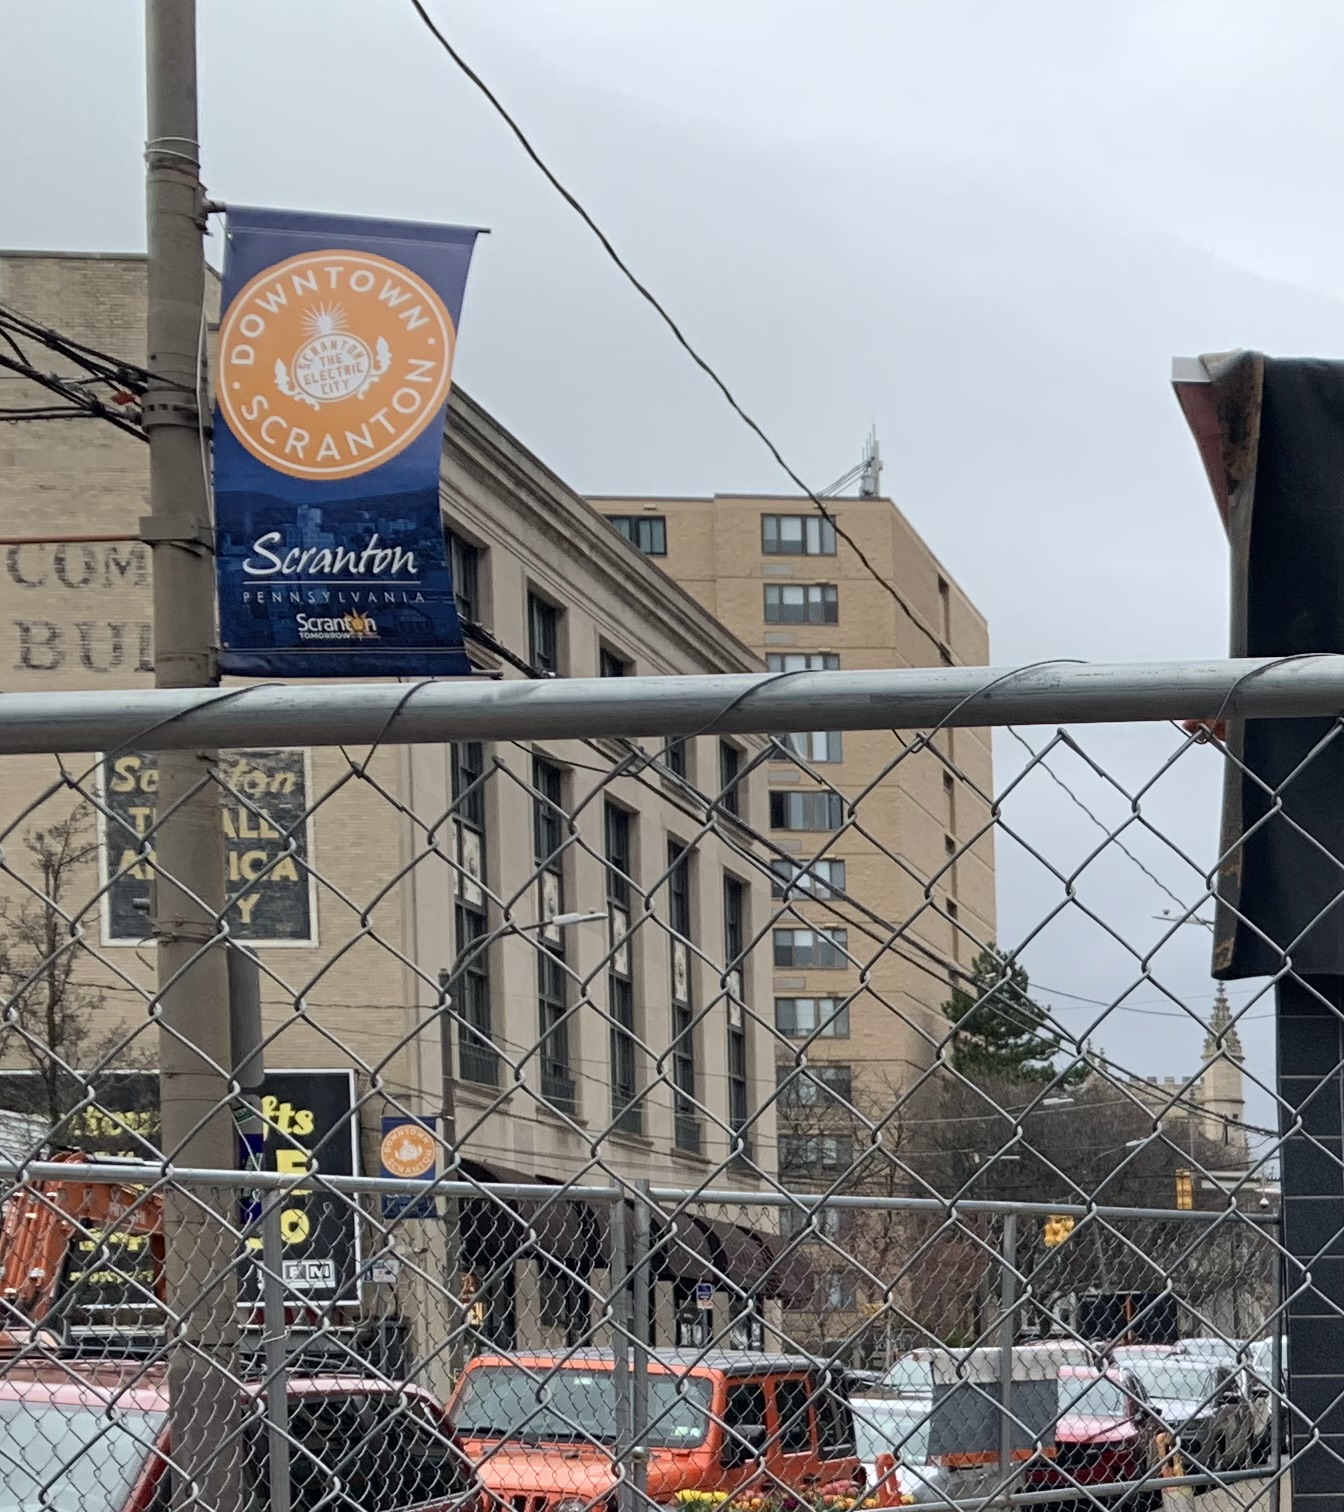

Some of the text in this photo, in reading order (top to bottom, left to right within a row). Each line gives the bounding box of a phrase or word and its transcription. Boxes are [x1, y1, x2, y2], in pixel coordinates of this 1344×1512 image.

[231, 266, 429, 365] DOWNTOWN
[298, 340, 365, 370] SCRANTON
[320, 353, 342, 367] THE
[303, 362, 363, 385] ELECTRIC
[321, 379, 349, 395] CITY
[241, 358, 437, 462] SCRANTON
[242, 531, 418, 576] Scranton
[243, 591, 425, 603] PENNSYLVANIA
[296, 608, 377, 633] Scranton
[299, 632, 350, 640] TOMORROW
[110, 756, 297, 798] Scton
[119, 850, 299, 881] AICA
[384, 1128, 431, 1153] DOWNTOWN
[386, 1149, 433, 1173] SCRANTON
